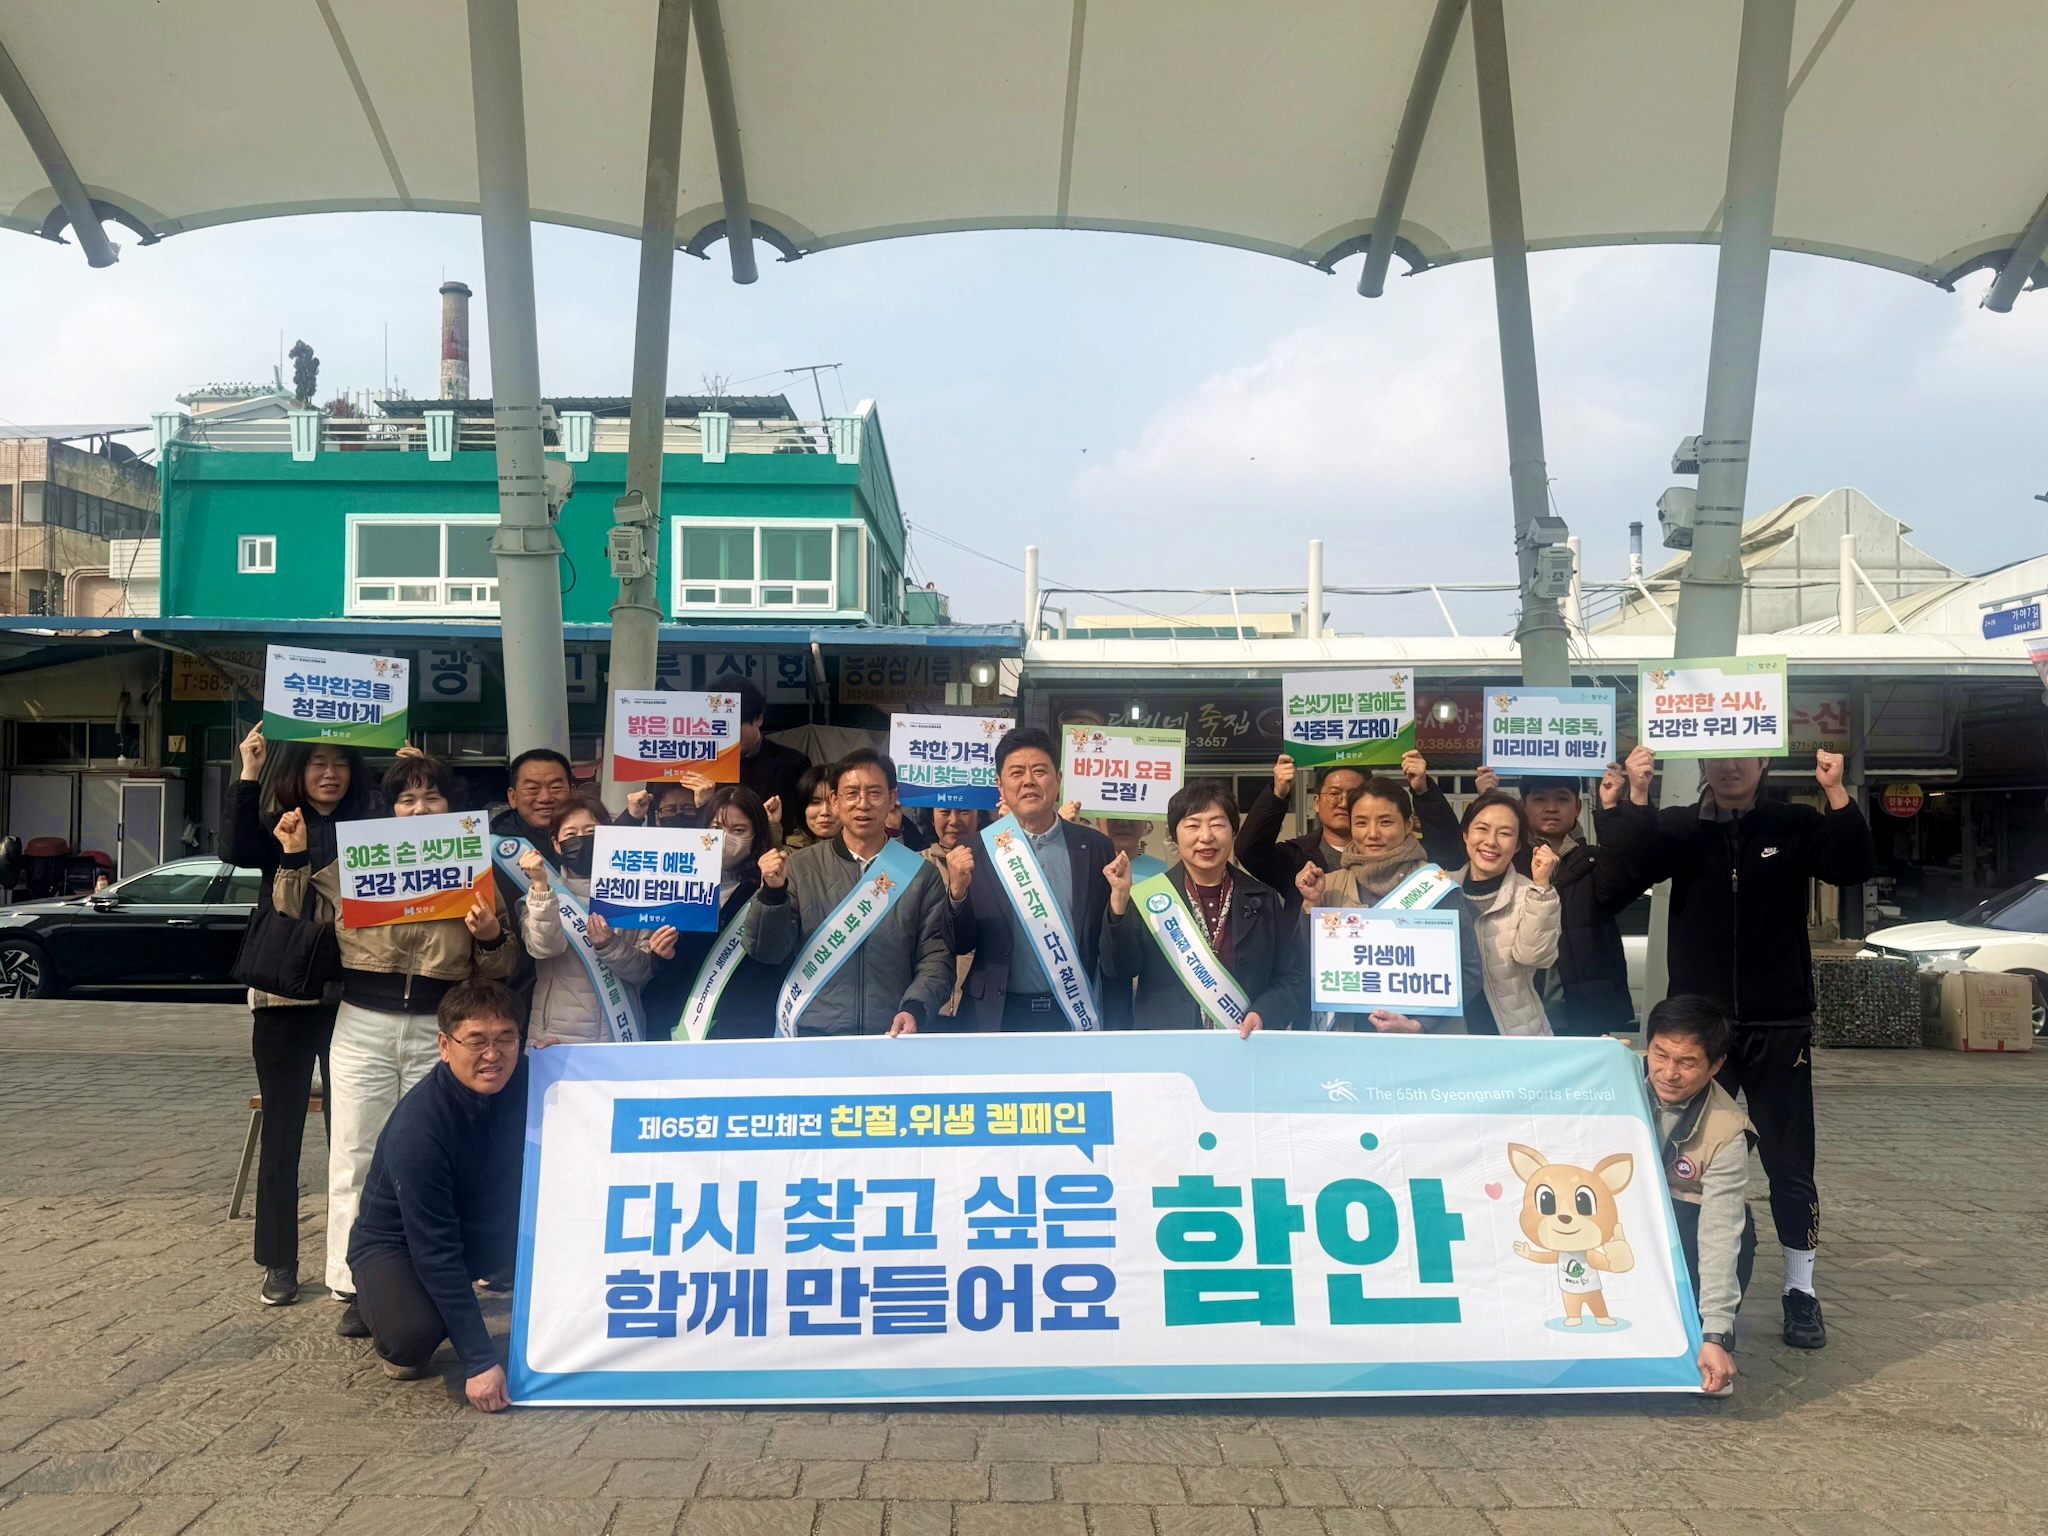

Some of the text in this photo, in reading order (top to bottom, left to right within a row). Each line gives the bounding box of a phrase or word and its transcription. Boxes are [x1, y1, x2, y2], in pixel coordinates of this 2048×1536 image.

[283, 672, 392, 700] 숙박환경을
[292, 698, 381, 723] 청결하게
[1289, 691, 1406, 715] 손씻기만 잘해도
[1655, 691, 1767, 714] 안전한 식사,
[628, 715, 727, 736] 밝은 미소로
[1198, 703, 1250, 737] 죽집
[1293, 720, 1343, 740] 식중독
[1493, 717, 1603, 736] 여름철 식중독,
[1648, 715, 1777, 738] 건강한 우리 가족
[639, 740, 716, 759] 친절하게
[909, 739, 994, 764] 착한 가격,
[1493, 739, 1607, 758] 미리미리 예방!
[897, 764, 931, 782] 다시
[934, 765, 968, 784] 찾는
[1074, 758, 1171, 780] 바가지 요금
[346, 836, 483, 869] 30초 손 씻기로
[611, 850, 698, 875] 식중독 예방,
[355, 872, 396, 897] 건강
[595, 877, 714, 903] 실천이 답입니다!
[802, 898, 873, 981] 숙박환경을
[1007, 854, 1032, 888] 착한
[1043, 930, 1067, 967] 다시
[1059, 966, 1080, 1001] 찾는
[1164, 916, 1191, 955] 여름철
[1353, 944, 1415, 967] 위생에
[1320, 970, 1451, 995] 친절을 더하다
[1366, 1086, 1616, 1103] The 65th Gyeongnam Sports Festival
[638, 1113, 719, 1140] 제65회
[726, 1112, 822, 1138] 도민체전
[986, 1102, 1087, 1135] 캠페인
[604, 1174, 1117, 1256] 다시 찾고 싶은
[1152, 1175, 1465, 1327] 함안
[605, 1263, 1120, 1339] 함께 만들어요
